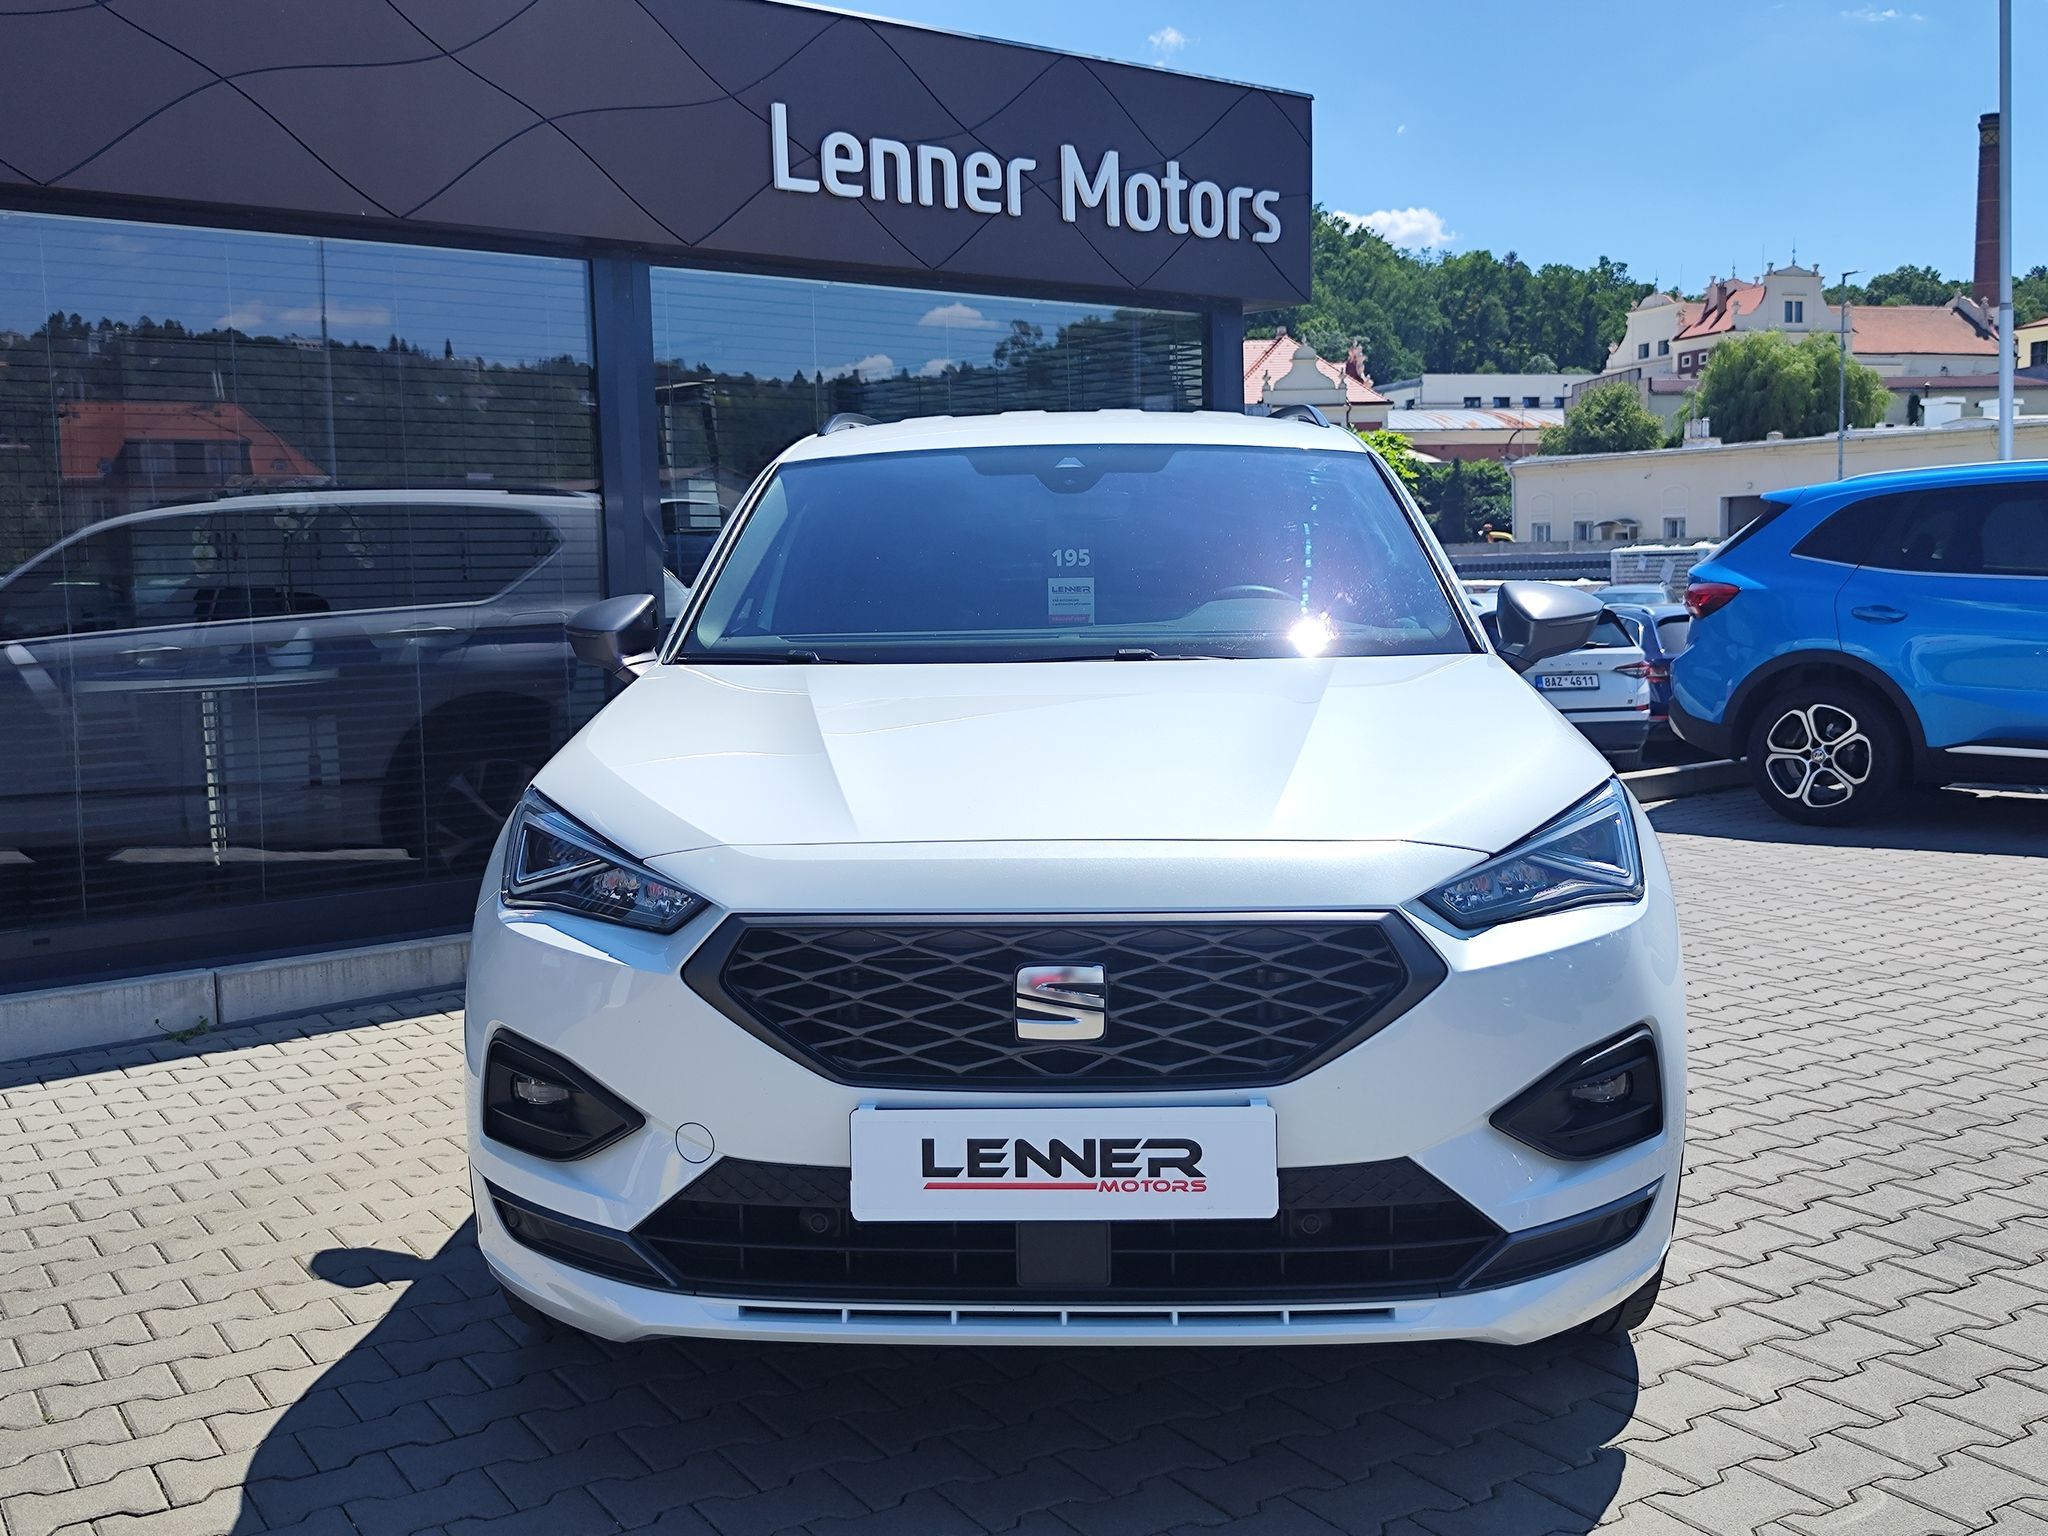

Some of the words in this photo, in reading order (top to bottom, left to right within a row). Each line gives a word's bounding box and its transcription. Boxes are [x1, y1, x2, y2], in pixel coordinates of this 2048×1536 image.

[770, 101, 1037, 217] Lenner
[1060, 143, 1282, 244] Motors
[1052, 548, 1090, 567] 195
[1051, 585, 1091, 594] LENNER
[1544, 677, 1563, 687] 8AZ
[1570, 676, 1594, 686] 4611
[921, 1137, 1208, 1179] LENNER
[1098, 1179, 1208, 1193] MOTORS
